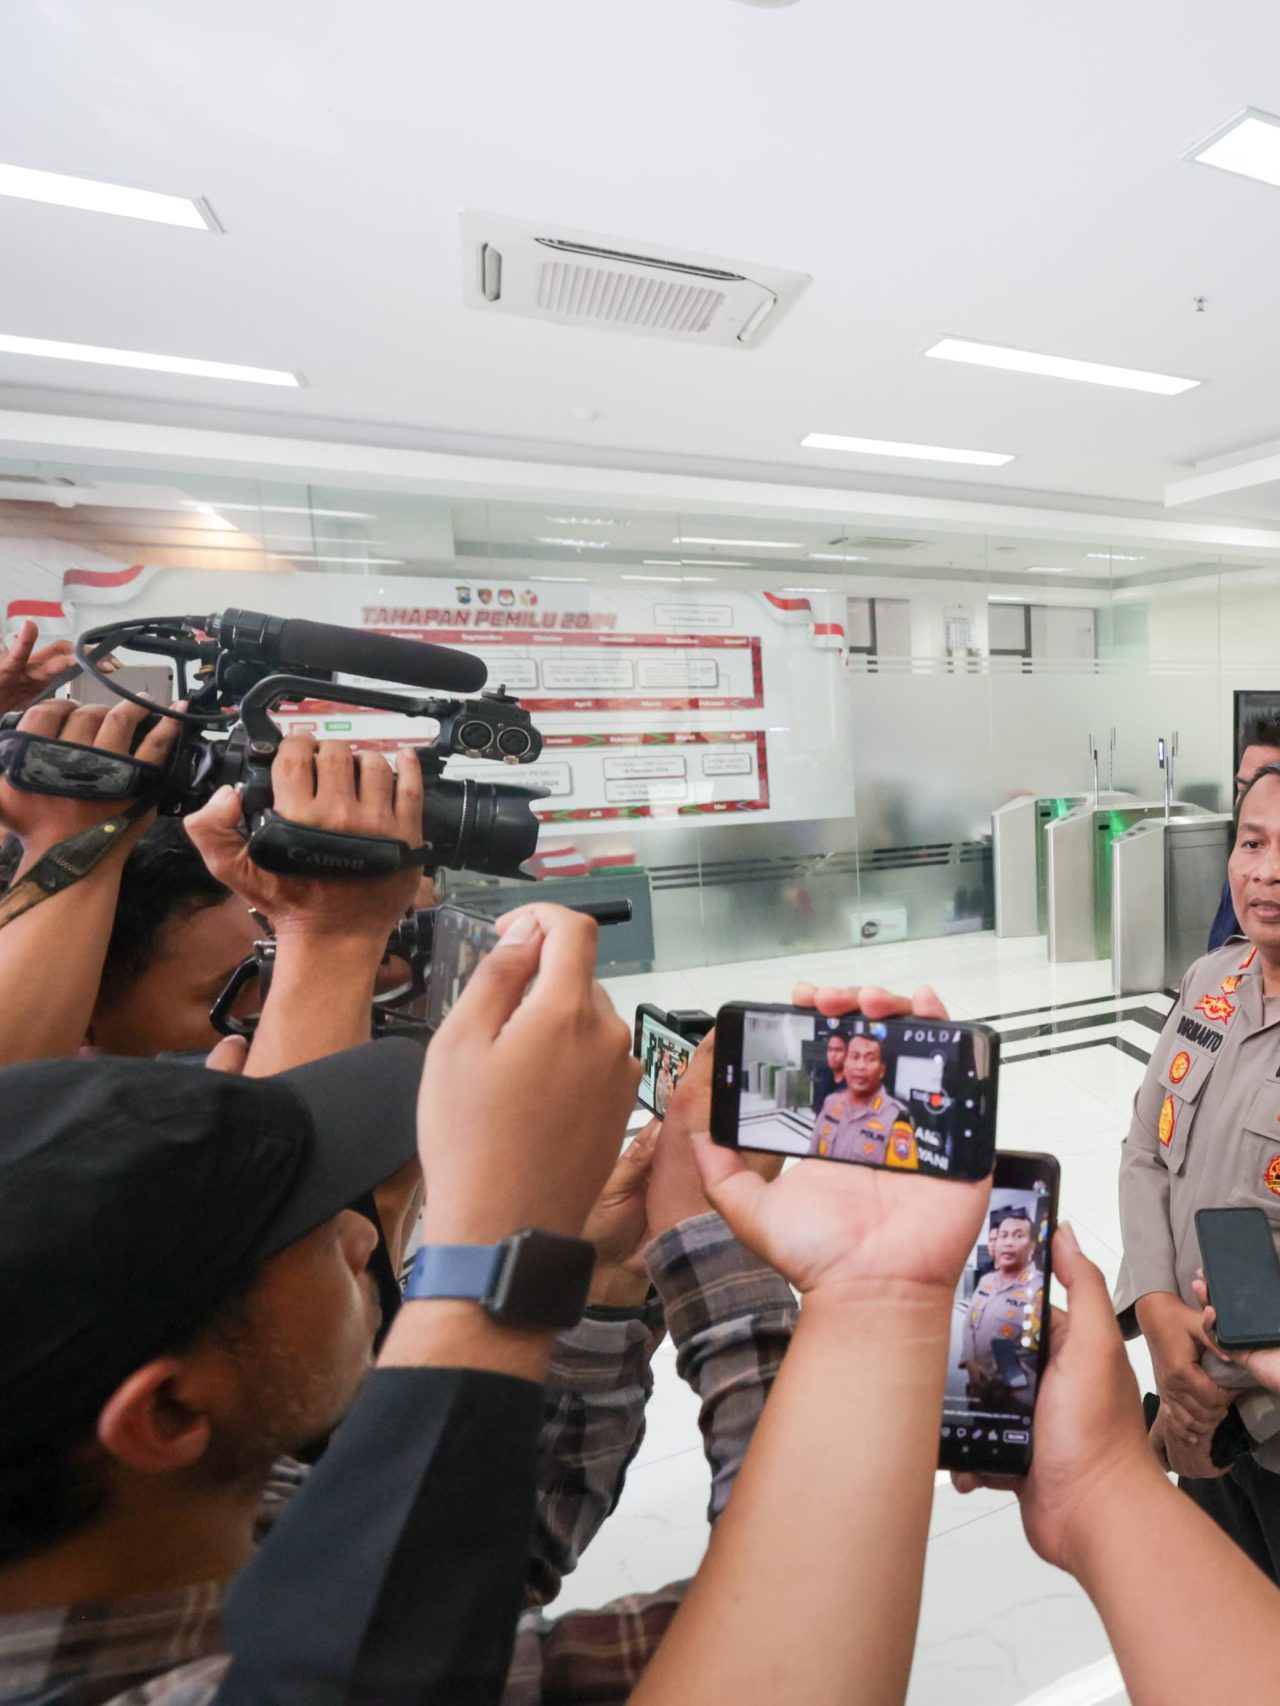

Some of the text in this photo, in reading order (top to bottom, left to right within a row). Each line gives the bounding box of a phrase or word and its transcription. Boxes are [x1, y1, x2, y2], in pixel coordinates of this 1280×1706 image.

[362, 606, 618, 630] TAHAPAN PEMILU 2024
